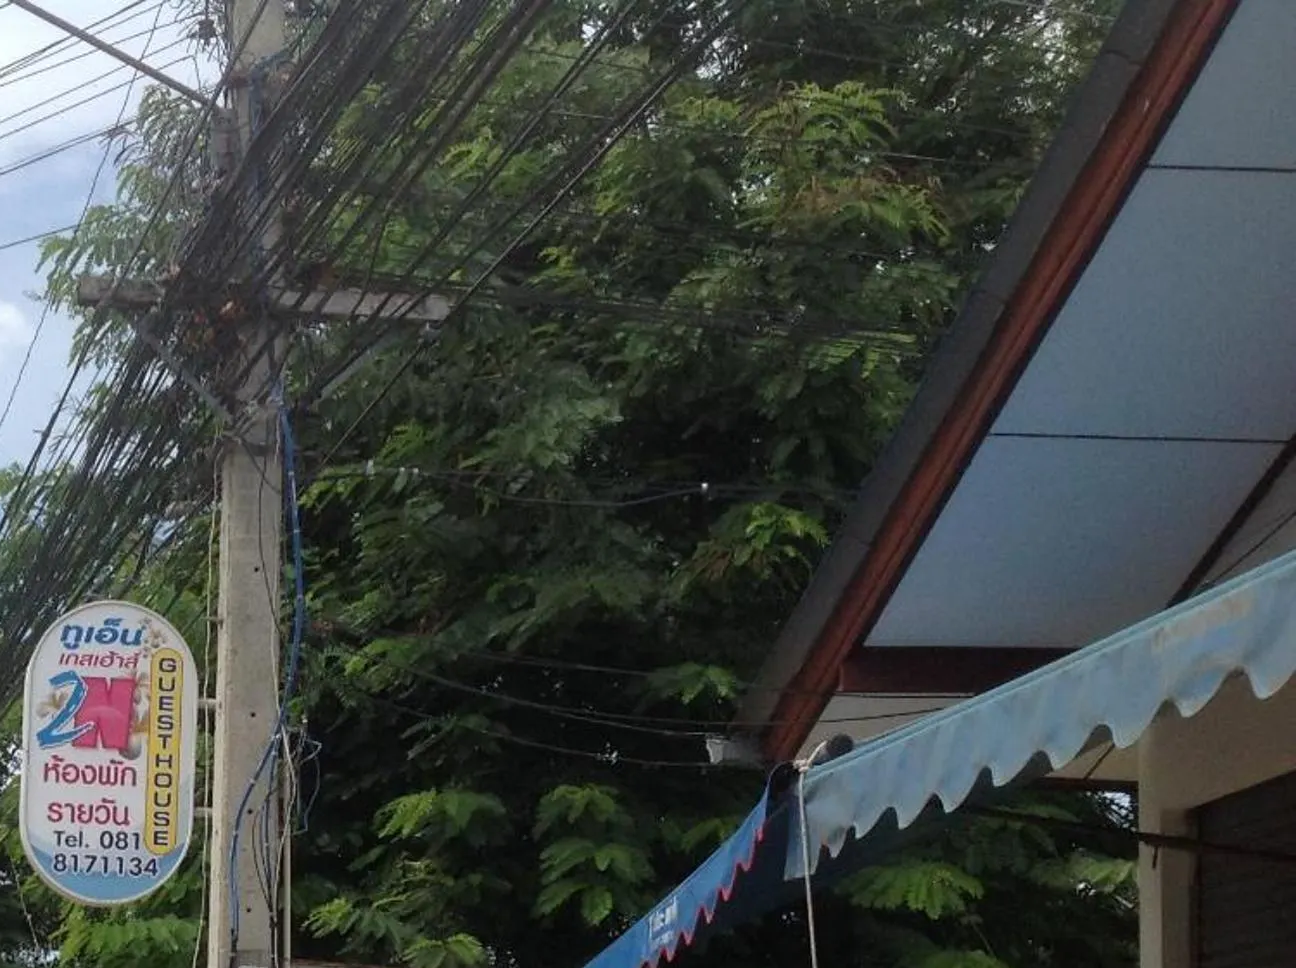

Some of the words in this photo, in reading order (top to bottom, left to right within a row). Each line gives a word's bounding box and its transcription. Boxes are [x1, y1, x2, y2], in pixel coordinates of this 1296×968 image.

[60, 617, 146, 650] ทูเอ็น
[44, 754, 138, 787] ห้องพัก
[47, 797, 131, 826] รายวัน
[53, 830, 91, 849] Tel.
[99, 830, 141, 851] 081
[53, 852, 159, 877] 8171134
